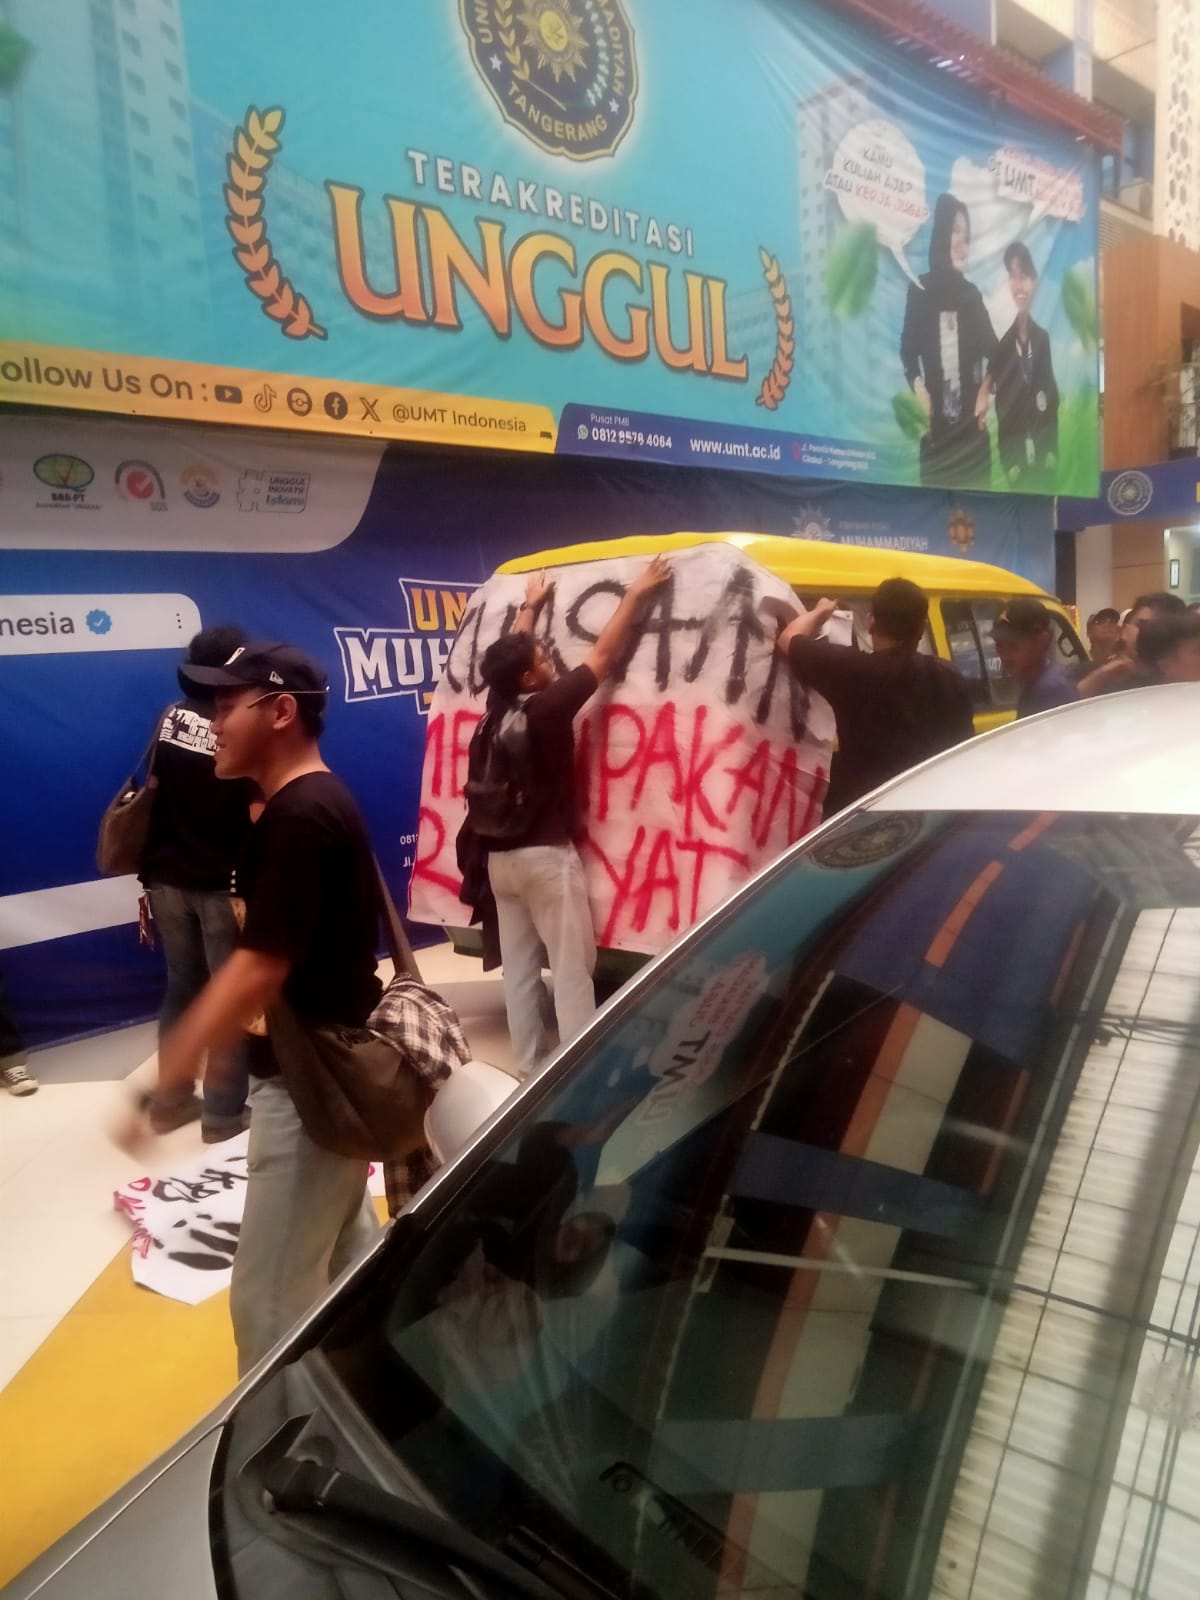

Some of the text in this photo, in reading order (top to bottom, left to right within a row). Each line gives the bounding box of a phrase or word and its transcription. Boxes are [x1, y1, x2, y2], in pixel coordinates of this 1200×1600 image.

[508, 80, 608, 142] TANGERANG
[825, 173, 854, 193] ATAU
[842, 159, 881, 185] KULIAH
[1004, 164, 1036, 197] UMT
[407, 150, 694, 257] TERAKREDITASI
[324, 180, 749, 383] UNGGUL
[102, 367, 142, 394] Us
[392, 403, 448, 423] @UMT
[452, 410, 527, 432] Indonesia
[591, 427, 617, 443] 0812
[690, 437, 782, 461] www.umt.ac.id
